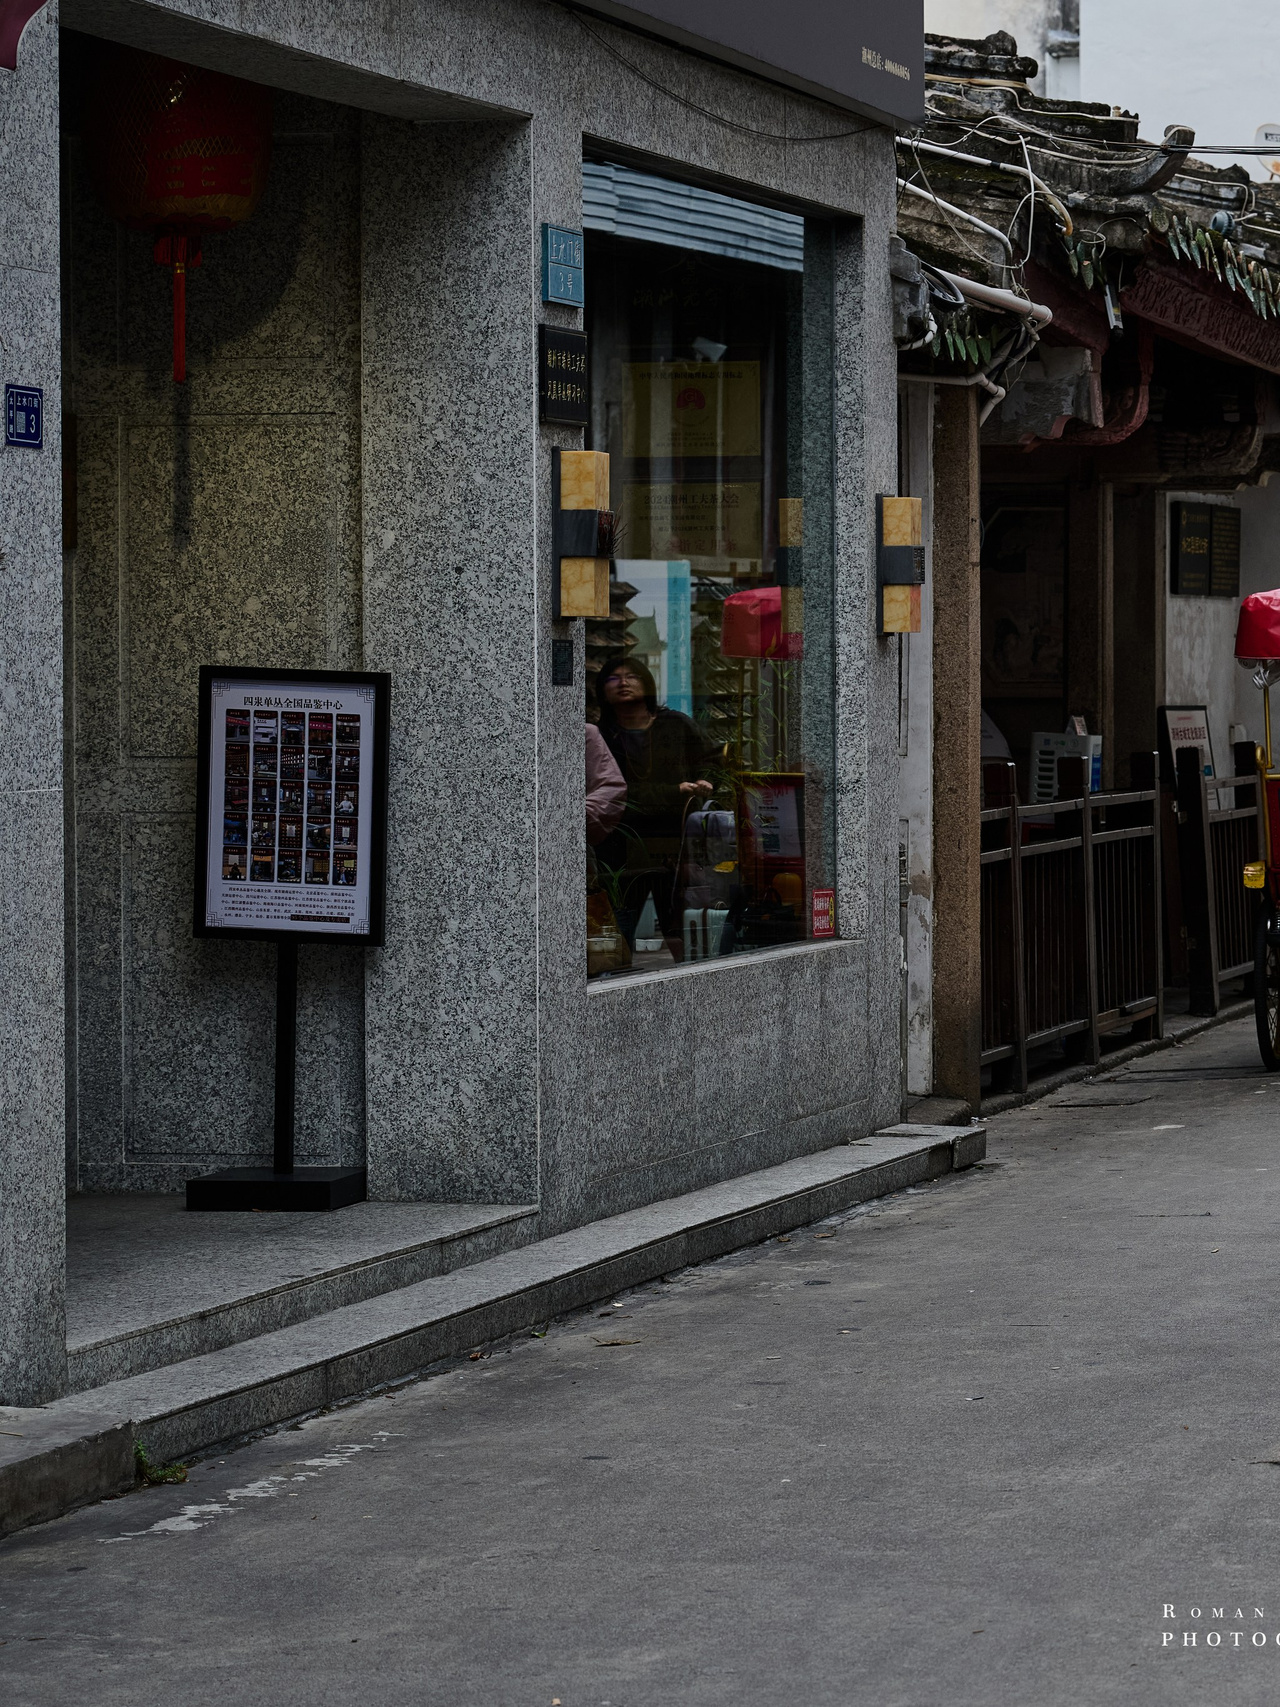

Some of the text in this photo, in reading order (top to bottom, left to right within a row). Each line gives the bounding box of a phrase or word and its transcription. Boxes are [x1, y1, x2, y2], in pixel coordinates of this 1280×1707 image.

[551, 235, 581, 265] 上水门街
[560, 272, 573, 295] 3号
[17, 395, 39, 409] 上水门街
[30, 414, 36, 433] 3
